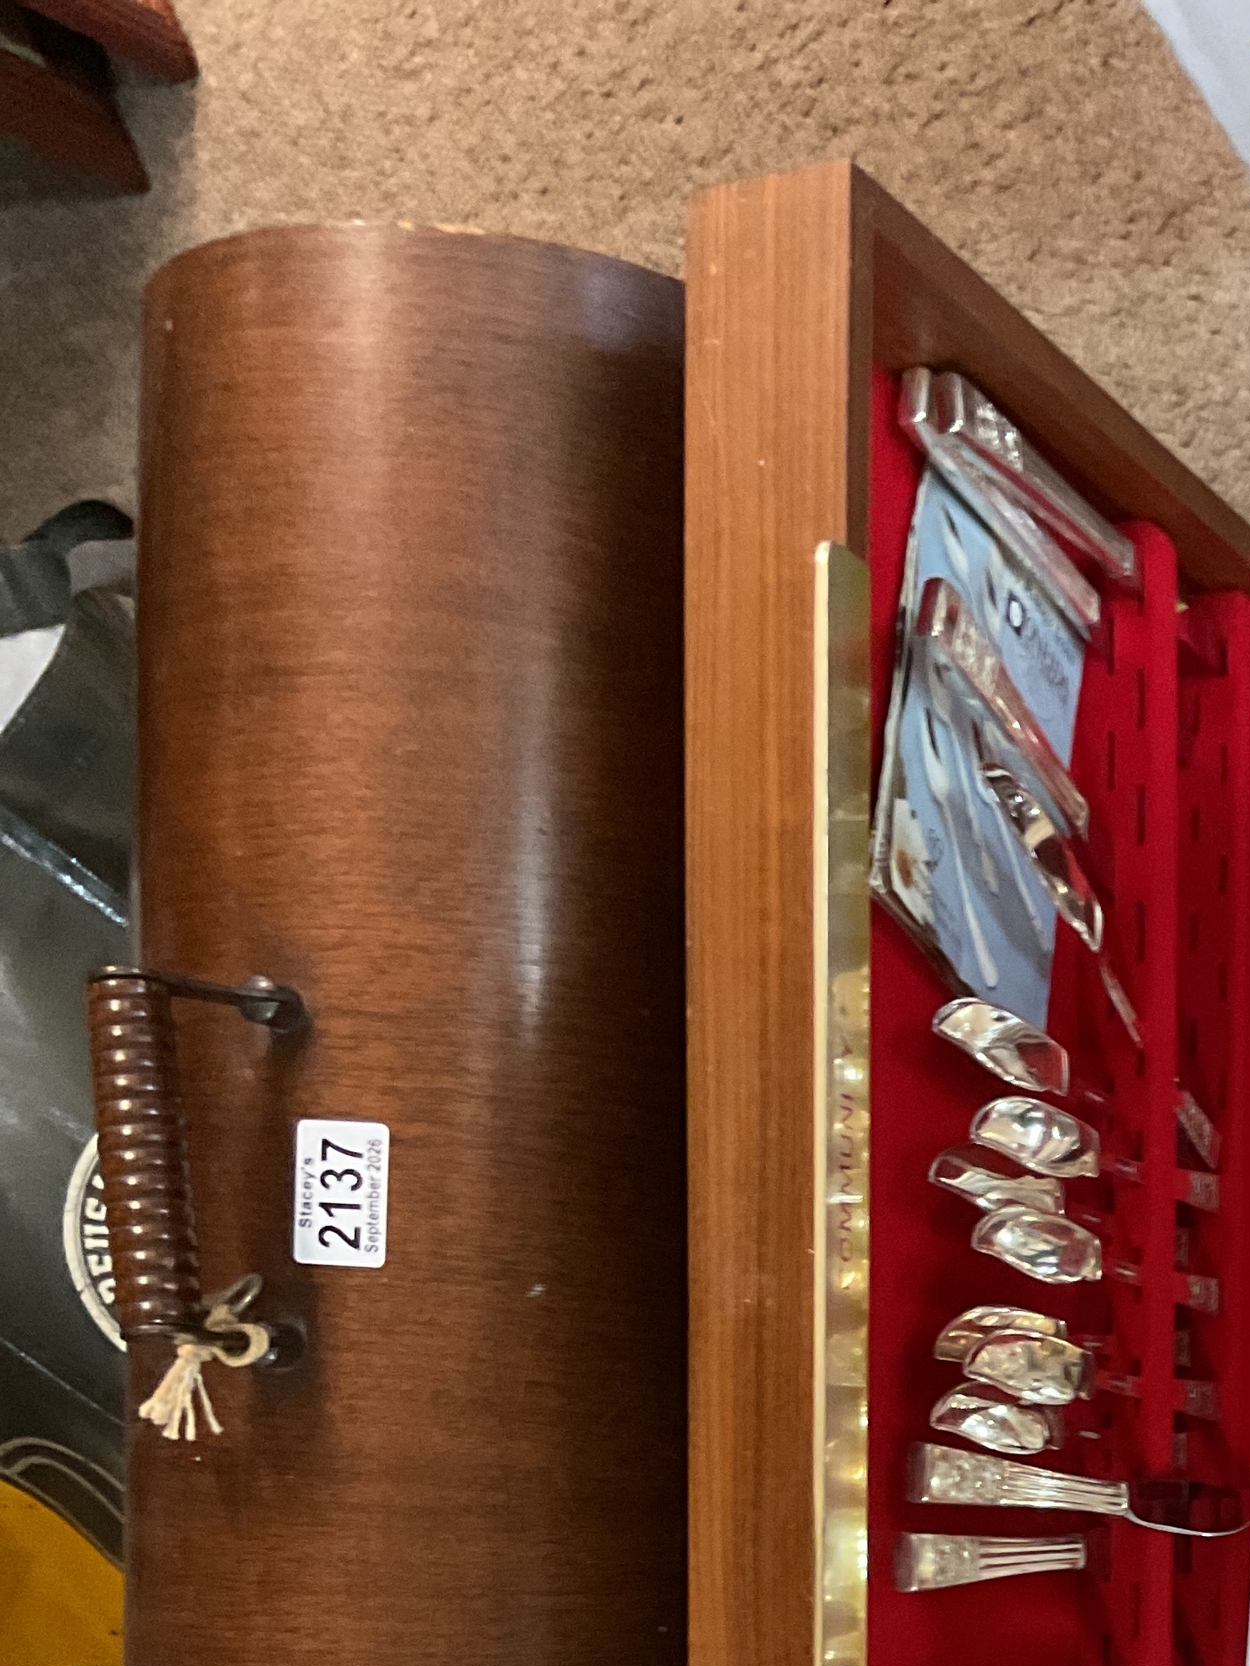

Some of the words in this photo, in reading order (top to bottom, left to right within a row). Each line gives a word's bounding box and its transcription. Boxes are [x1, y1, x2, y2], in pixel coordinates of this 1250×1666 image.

[365, 1138, 383, 1172] 2026
[298, 1157, 316, 1229] Stacey's
[318, 1138, 363, 1250] 2137
[364, 1176, 382, 1253] September
